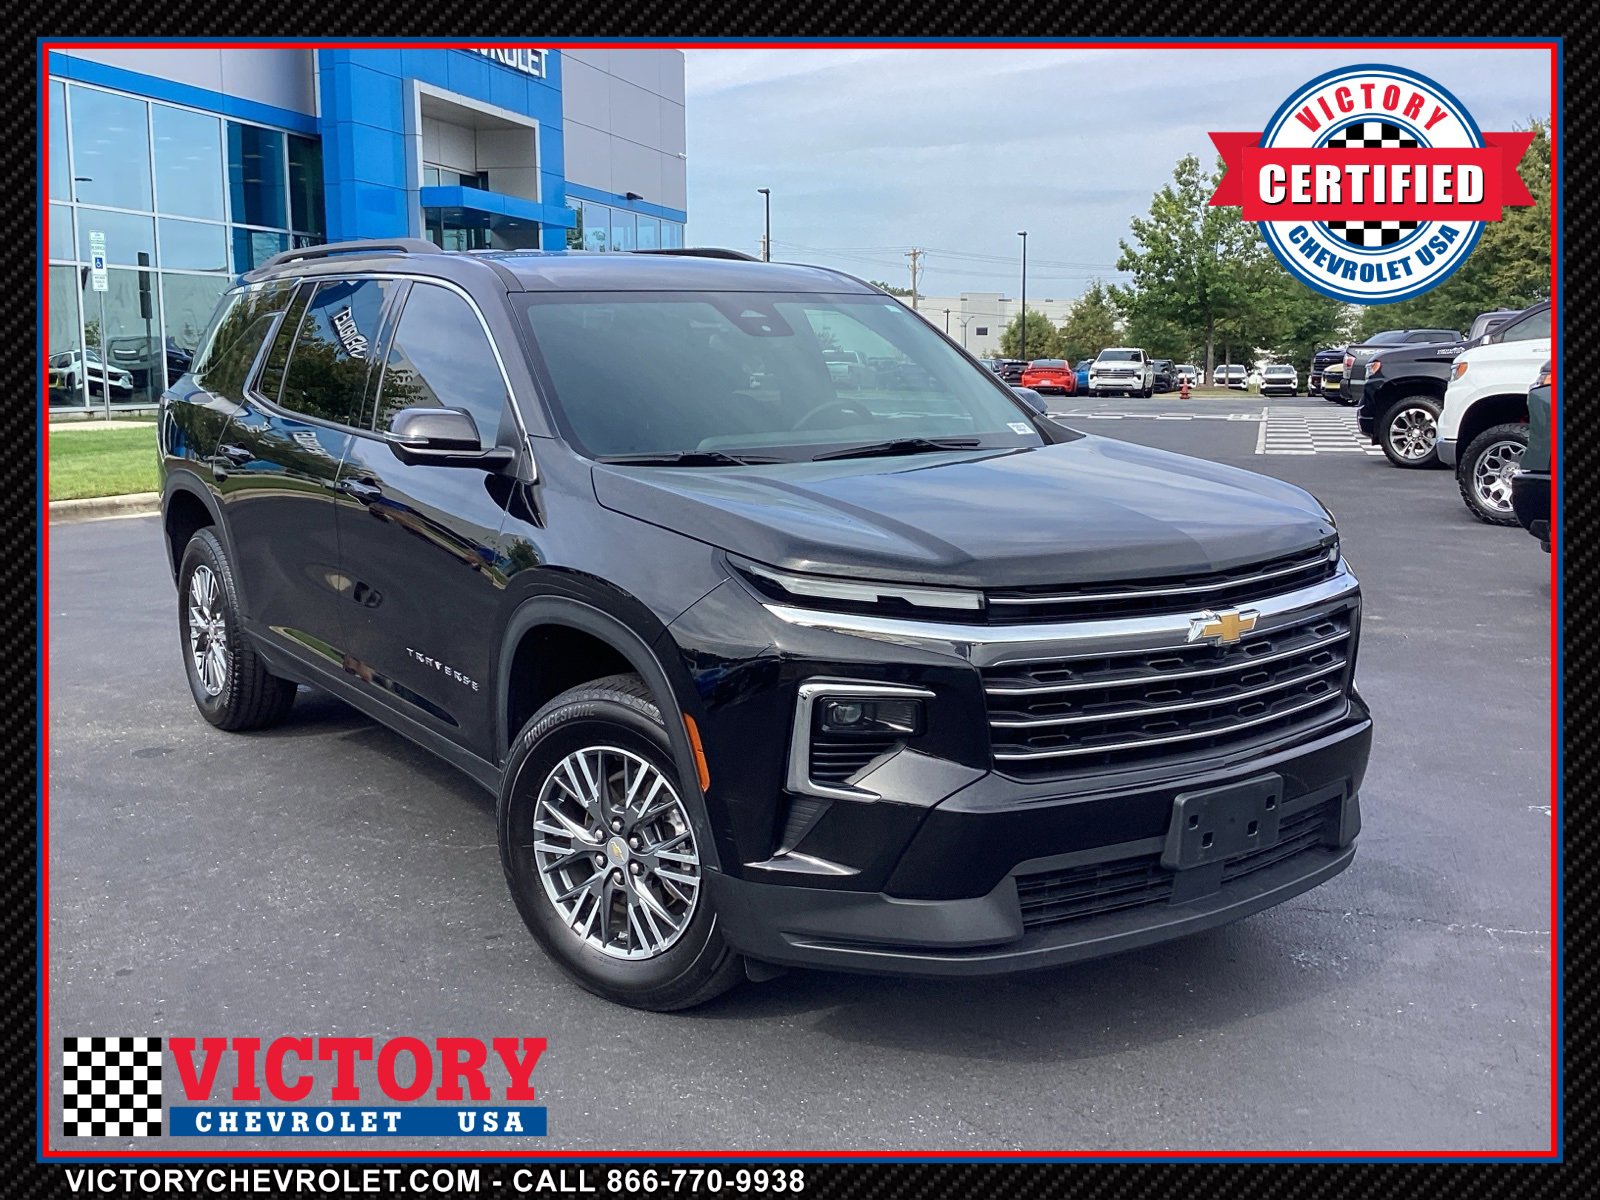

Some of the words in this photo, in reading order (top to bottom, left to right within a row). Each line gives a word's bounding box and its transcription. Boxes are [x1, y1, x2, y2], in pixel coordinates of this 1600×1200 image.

[467, 48, 549, 79] ROLET
[406, 647, 479, 691] TRAVERSE
[524, 703, 596, 750] BRIDGESTONE
